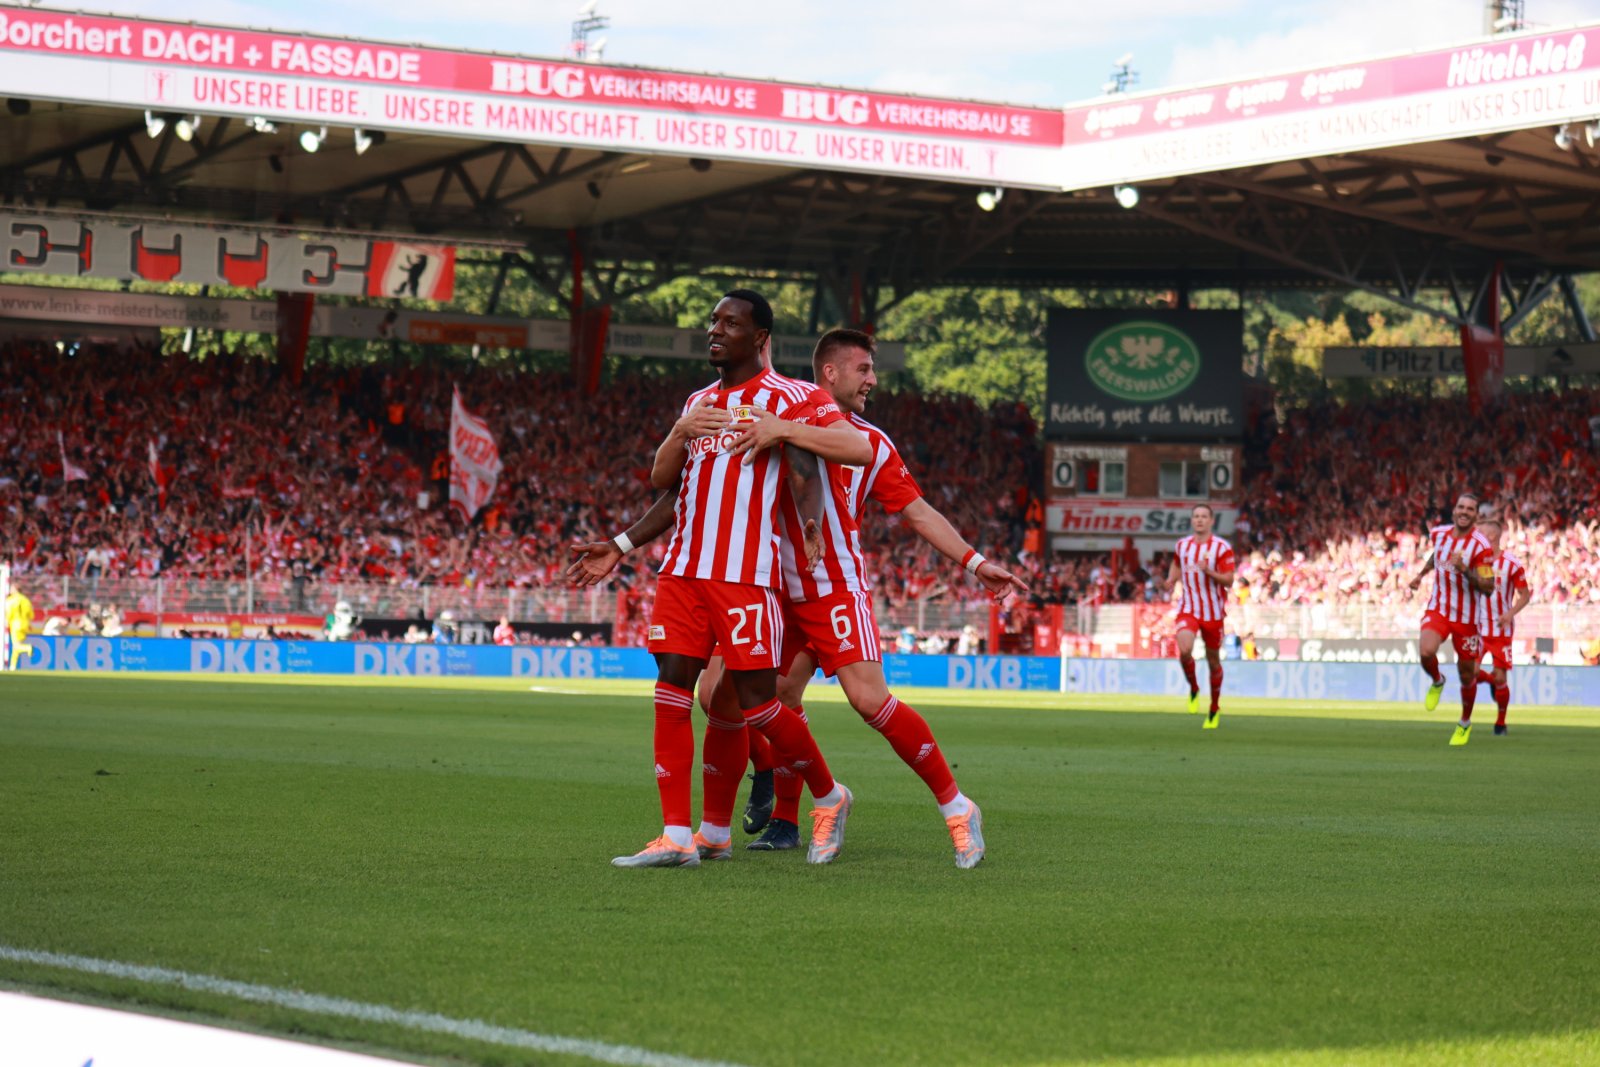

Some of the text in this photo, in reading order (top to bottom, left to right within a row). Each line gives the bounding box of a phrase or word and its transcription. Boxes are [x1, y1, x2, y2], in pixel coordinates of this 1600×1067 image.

[142, 28, 234, 64] DACH
[243, 45, 263, 67] +
[271, 41, 421, 82] FASSADE
[491, 61, 757, 109] BUG VERKEHRSBAU SE
[194, 76, 971, 171] UNSERE LIEBE. UNSERE MANNSCHAFT. UNSER STOLZ. UNSER VEREIN.
[780, 88, 1031, 136] BUG VERKEHRSBAU SE
[1448, 93, 1504, 124] UNSER
[1091, 357, 1193, 393] EBERSWALDER
[1382, 350, 1432, 373] Piltz
[1051, 403, 1105, 428] Richtig
[1112, 406, 1142, 429] gut
[1148, 404, 1172, 424] die
[1055, 461, 1073, 486] 0
[1213, 464, 1231, 488] 0
[1144, 510, 1224, 532] Stal
[727, 603, 764, 645] 27
[830, 604, 852, 640] 6
[20, 638, 115, 671] DKB
[191, 640, 282, 674] DKB
[354, 644, 441, 677] DKB
[511, 647, 595, 679] DKB
[949, 658, 1022, 690] DKB
[1068, 660, 1120, 692] DKB
[1266, 662, 1326, 698] DKB
